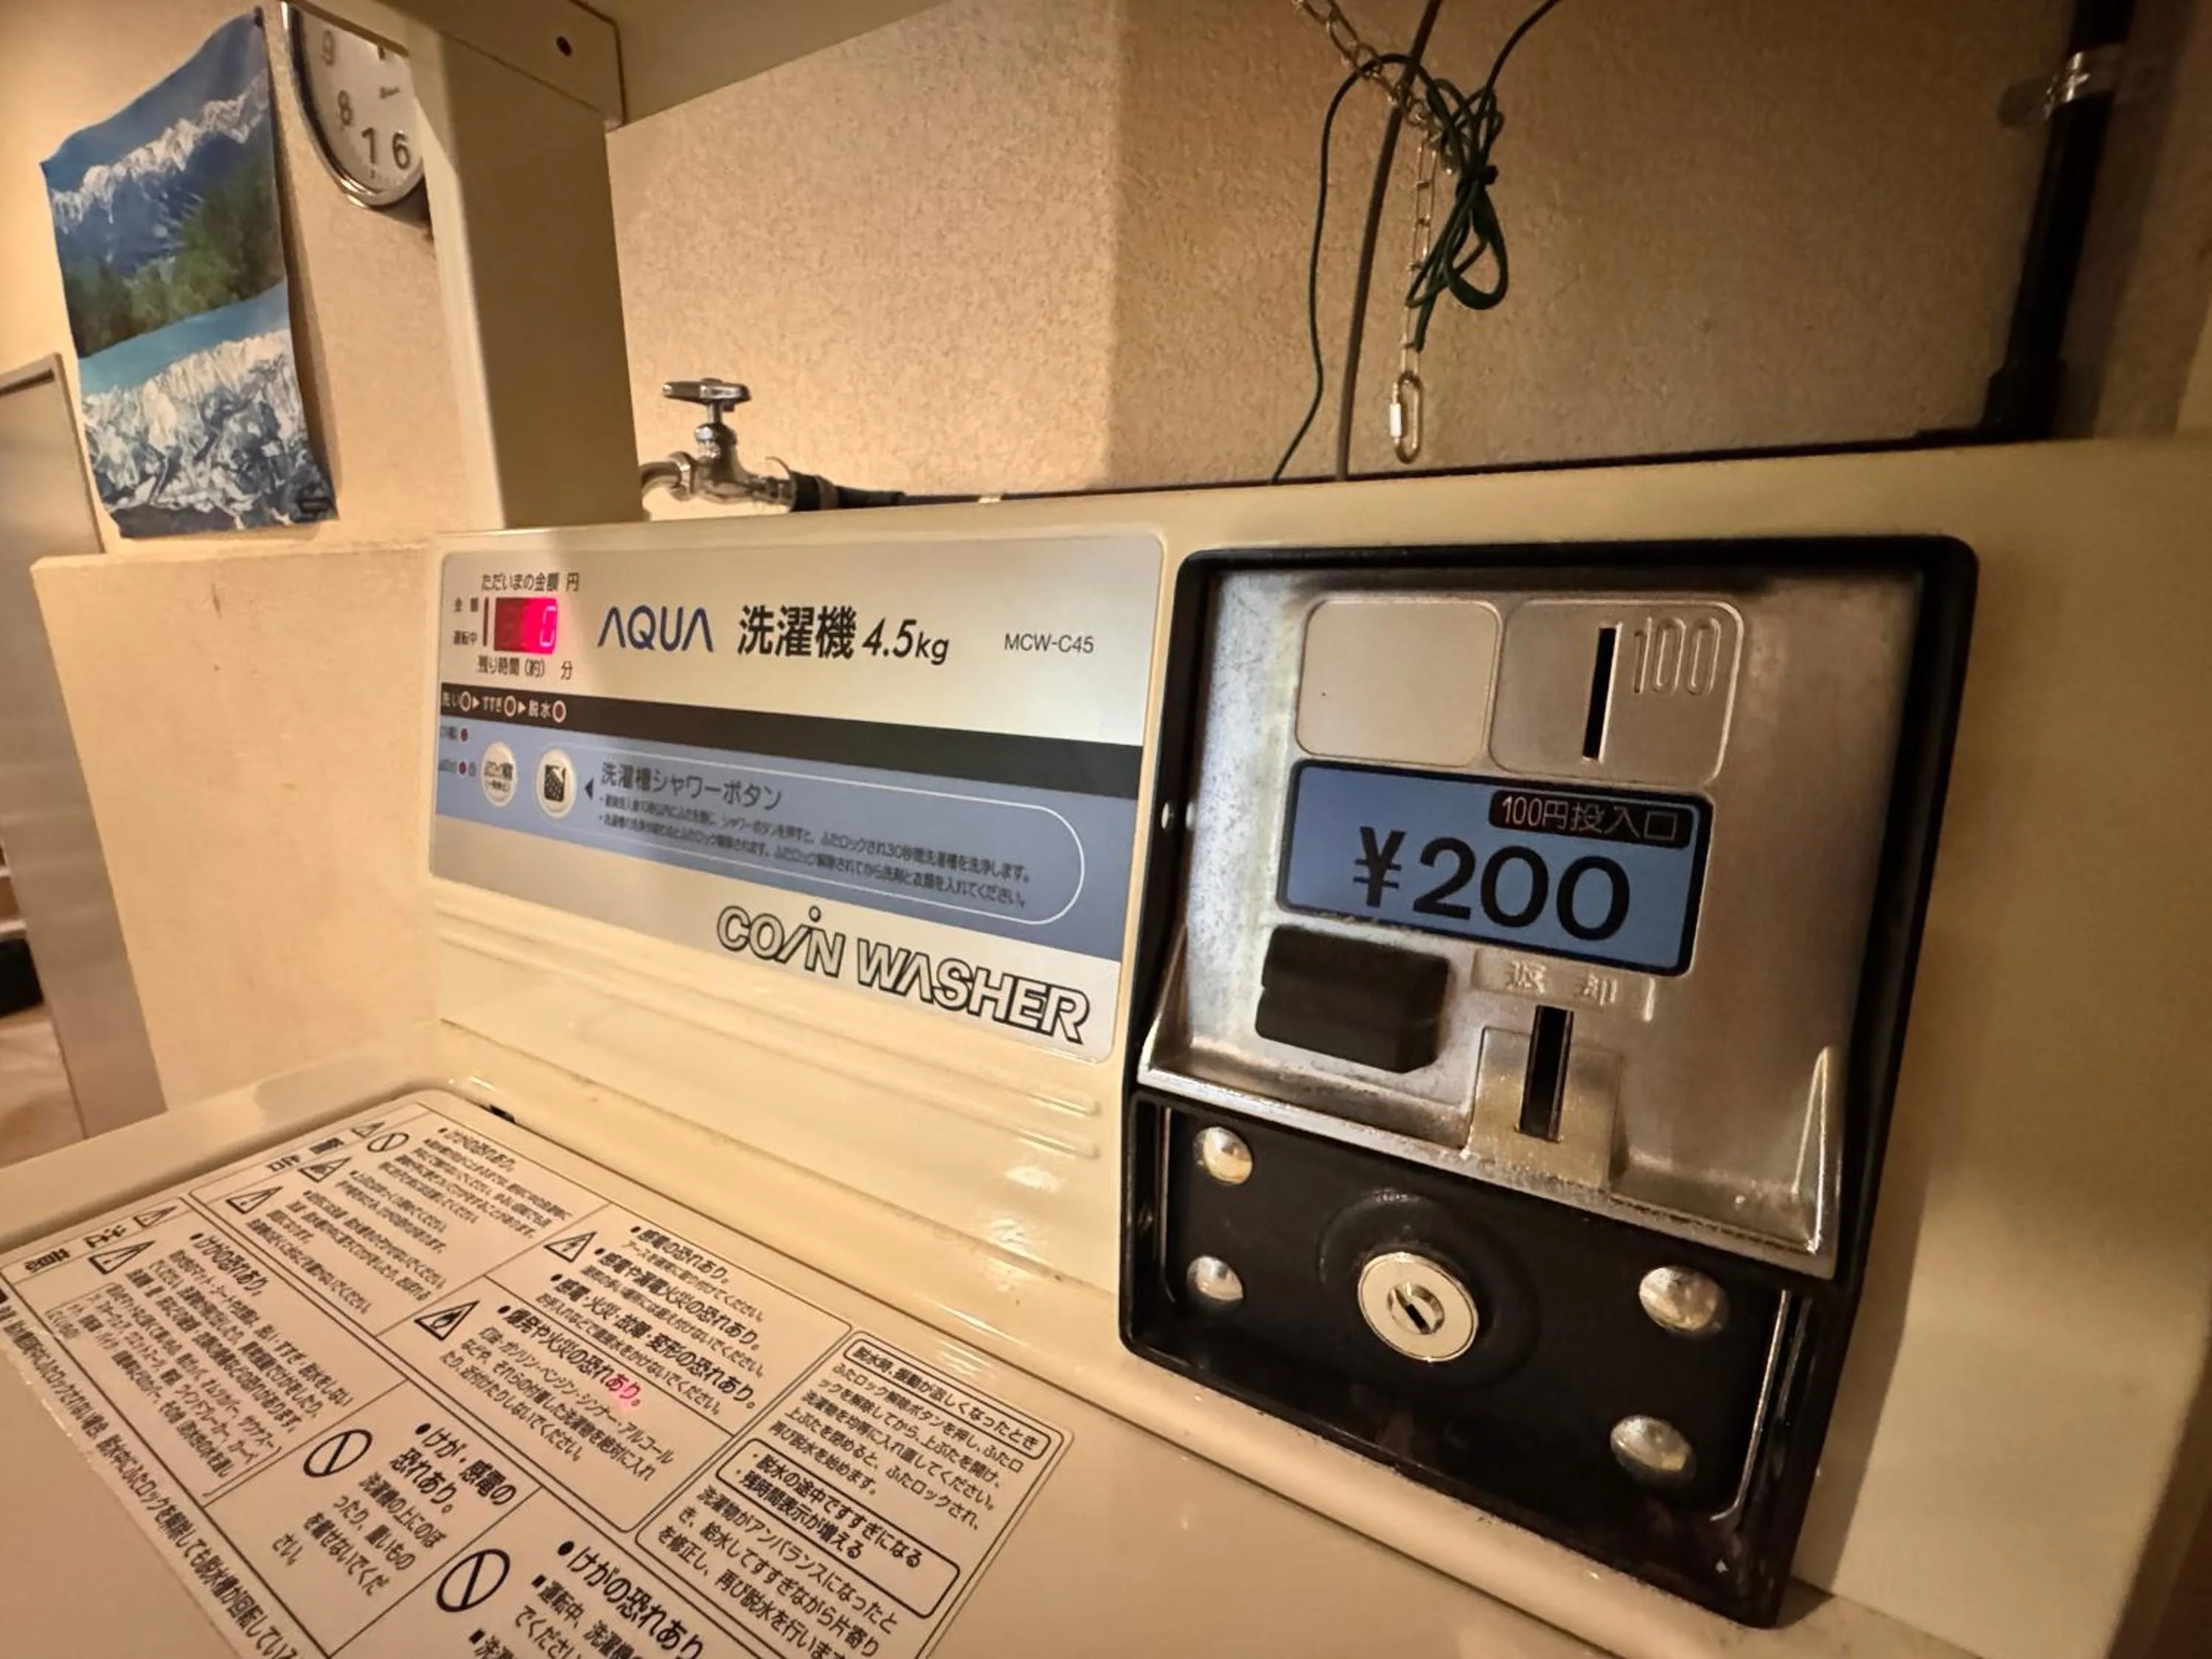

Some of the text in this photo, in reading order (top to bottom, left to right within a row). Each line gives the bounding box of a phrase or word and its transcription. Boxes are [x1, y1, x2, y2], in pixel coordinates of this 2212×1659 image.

[337, 89, 353, 126] 8
[392, 131, 411, 170] 6
[566, 571, 580, 591] 円
[597, 605, 714, 653] AQUA
[737, 605, 1095, 666] 洗濯機 4.5kg MCW-C45
[1633, 616, 1722, 695] 100
[560, 660, 574, 681] 分
[600, 762, 783, 812] 洗濯槽シャワーボタン
[1502, 795, 1678, 843] 100円投入口
[855, 936, 1091, 1045] WASHER
[389, 1446, 457, 1514] 恐れあり。
[421, 1427, 518, 1506] けが・感電の
[678, 1506, 879, 1658] き、給水してすすぎながら片寄り
[697, 1485, 897, 1633] 洗濯物がアンバランスになったと
[538, 1581, 643, 1659] 運転中、洗濯機
